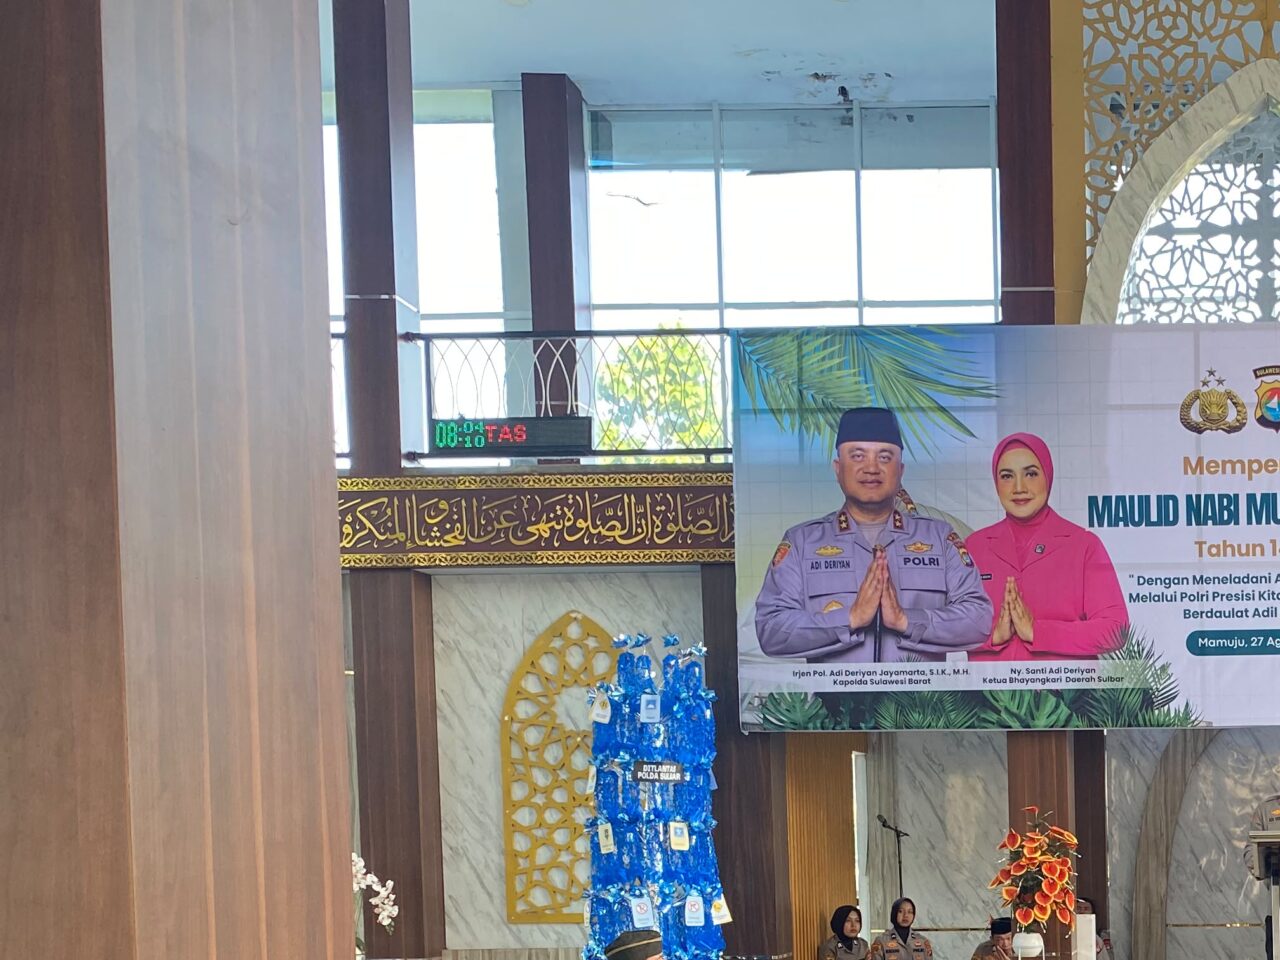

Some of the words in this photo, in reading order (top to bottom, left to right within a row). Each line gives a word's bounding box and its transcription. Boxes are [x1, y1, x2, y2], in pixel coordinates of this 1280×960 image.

[485, 424, 527, 442] TAS
[1088, 494, 1179, 528] MAULID
[1186, 493, 1239, 526] NABI
[1194, 539, 1265, 558] Tahun
[810, 560, 822, 570] ADI
[824, 560, 850, 569] DERIYAN
[903, 557, 940, 566] POLRI
[1137, 575, 1189, 589] Dengan
[1193, 572, 1271, 585] Meneladani
[1128, 591, 1177, 603] Melalui
[1180, 590, 1209, 602] Polri
[1212, 590, 1255, 602] Presisi
[1183, 607, 1249, 619] Berdaulat
[1252, 606, 1277, 618] Adil
[1198, 637, 1248, 648] Mamuju,
[1250, 637, 1264, 647] 27
[792, 670, 811, 679] Irjen
[812, 669, 828, 677] Pol.
[829, 669, 843, 677] Adi
[845, 669, 877, 679] Deriyan
[1049, 666, 1062, 674] Adi
[1063, 666, 1096, 675] Deriyan
[833, 678, 868, 687] Kapolda
[869, 678, 907, 686] Sulawesi
[908, 677, 931, 685] Barat
[1009, 676, 1062, 685] Bhayangkari
[637, 771, 659, 780] POLDA
